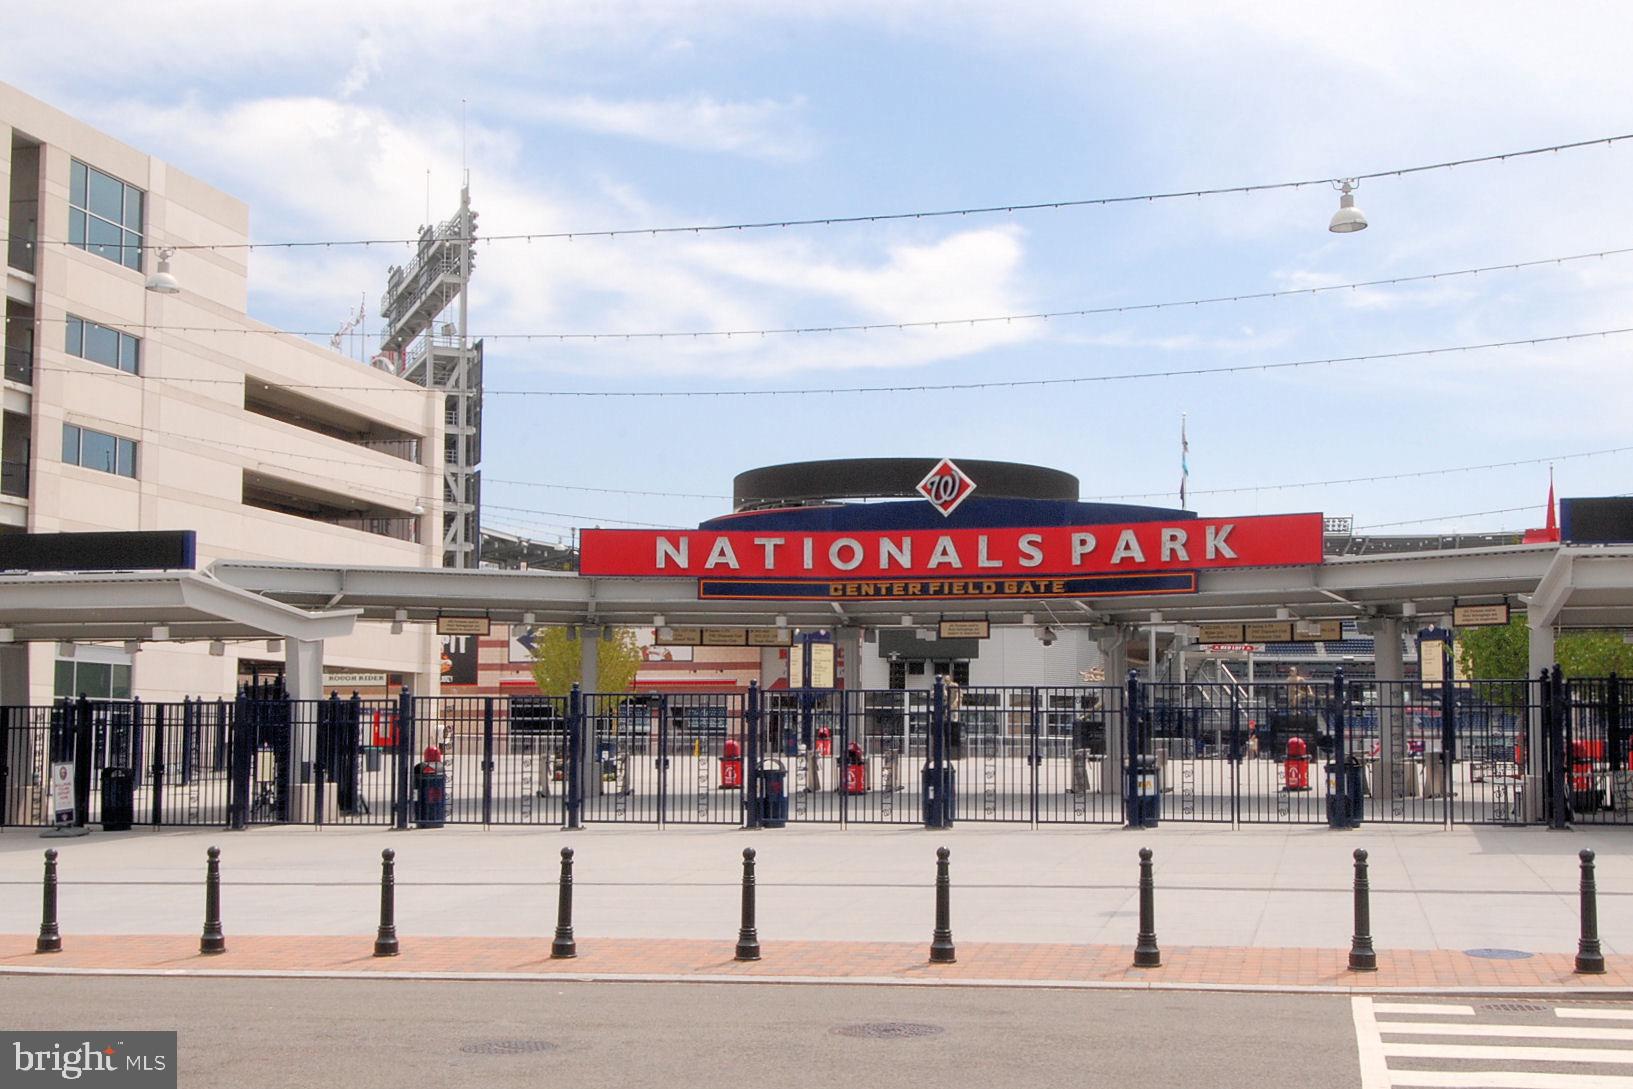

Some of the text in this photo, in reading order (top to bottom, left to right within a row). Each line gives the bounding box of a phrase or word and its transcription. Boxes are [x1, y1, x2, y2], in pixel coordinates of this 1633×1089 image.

[656, 524, 1238, 571] NATIONALS PARK
[828, 580, 1067, 597] CENTER FIELD GATE
